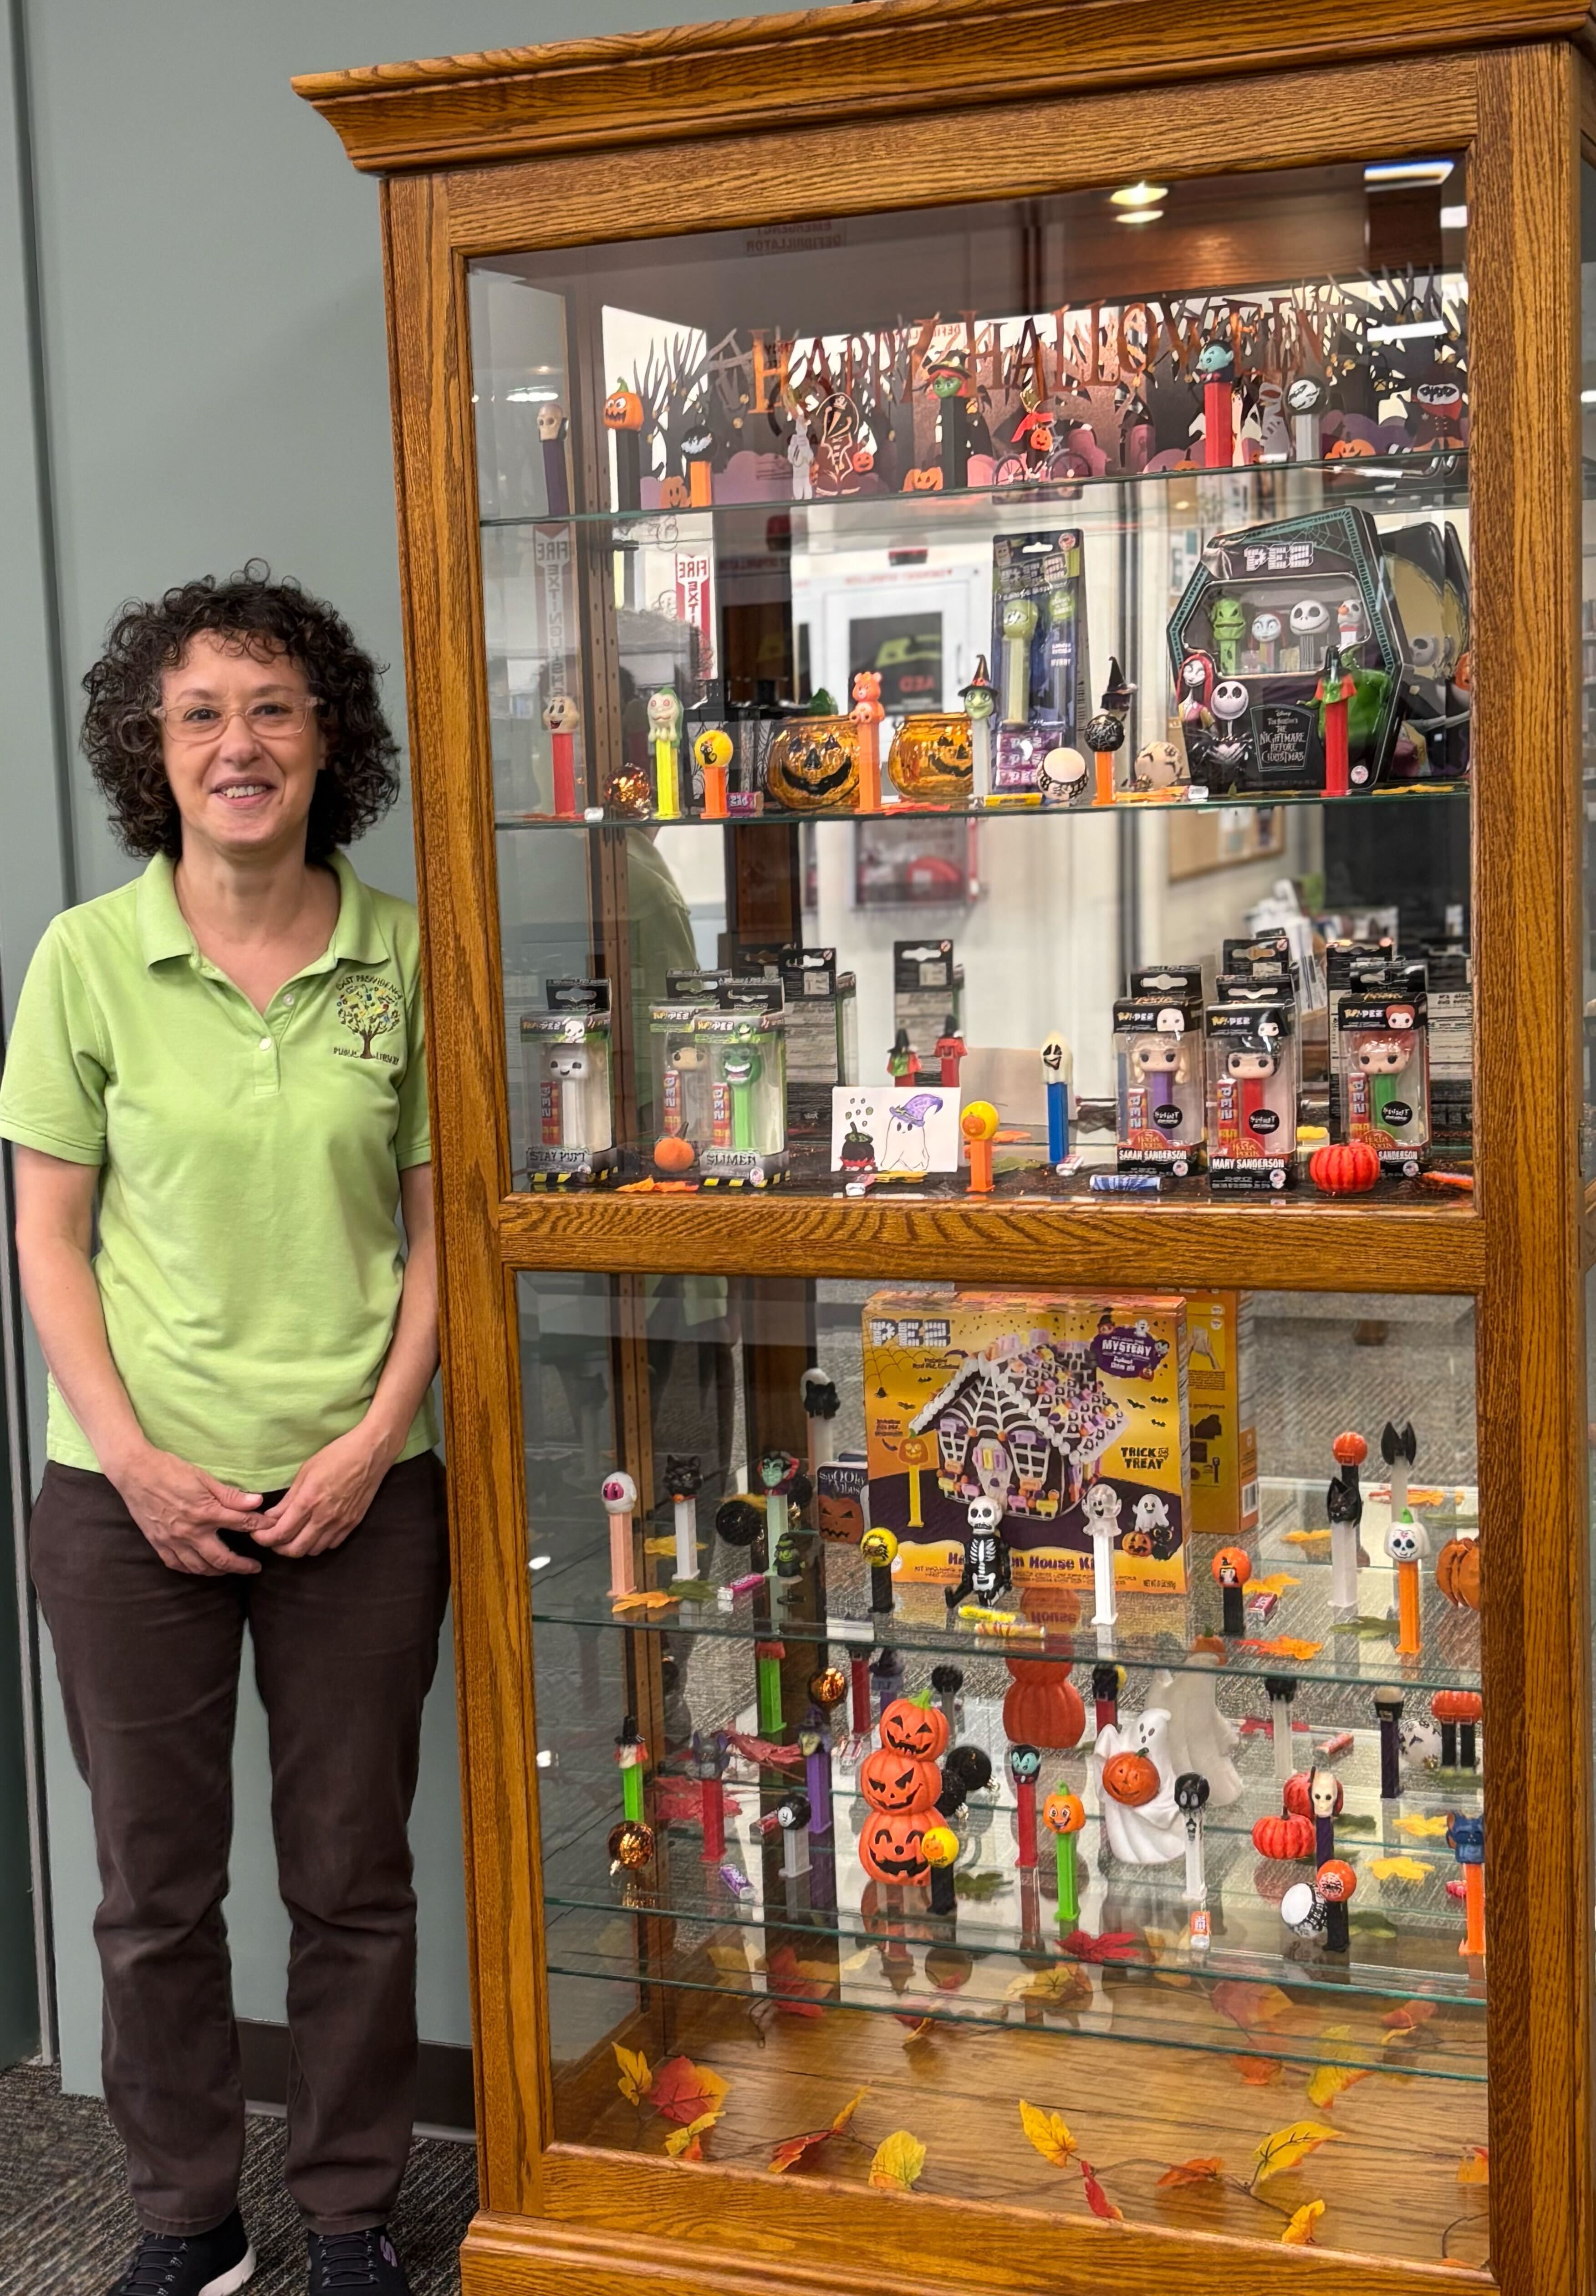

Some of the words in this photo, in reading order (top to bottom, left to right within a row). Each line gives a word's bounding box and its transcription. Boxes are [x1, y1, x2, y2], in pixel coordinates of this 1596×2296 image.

[1243, 543, 1313, 571] PEZ
[1260, 731, 1306, 745] NIGHTMARE
[1378, 1151, 1418, 1160] SANDERSON
[869, 1319, 950, 1346] PEZ
[1102, 1339, 1152, 1356] MYSTERY
[1121, 1447, 1157, 1457] TRICK
[1124, 1458, 1164, 1469] TREAT
[1030, 1556, 1075, 1570] House
